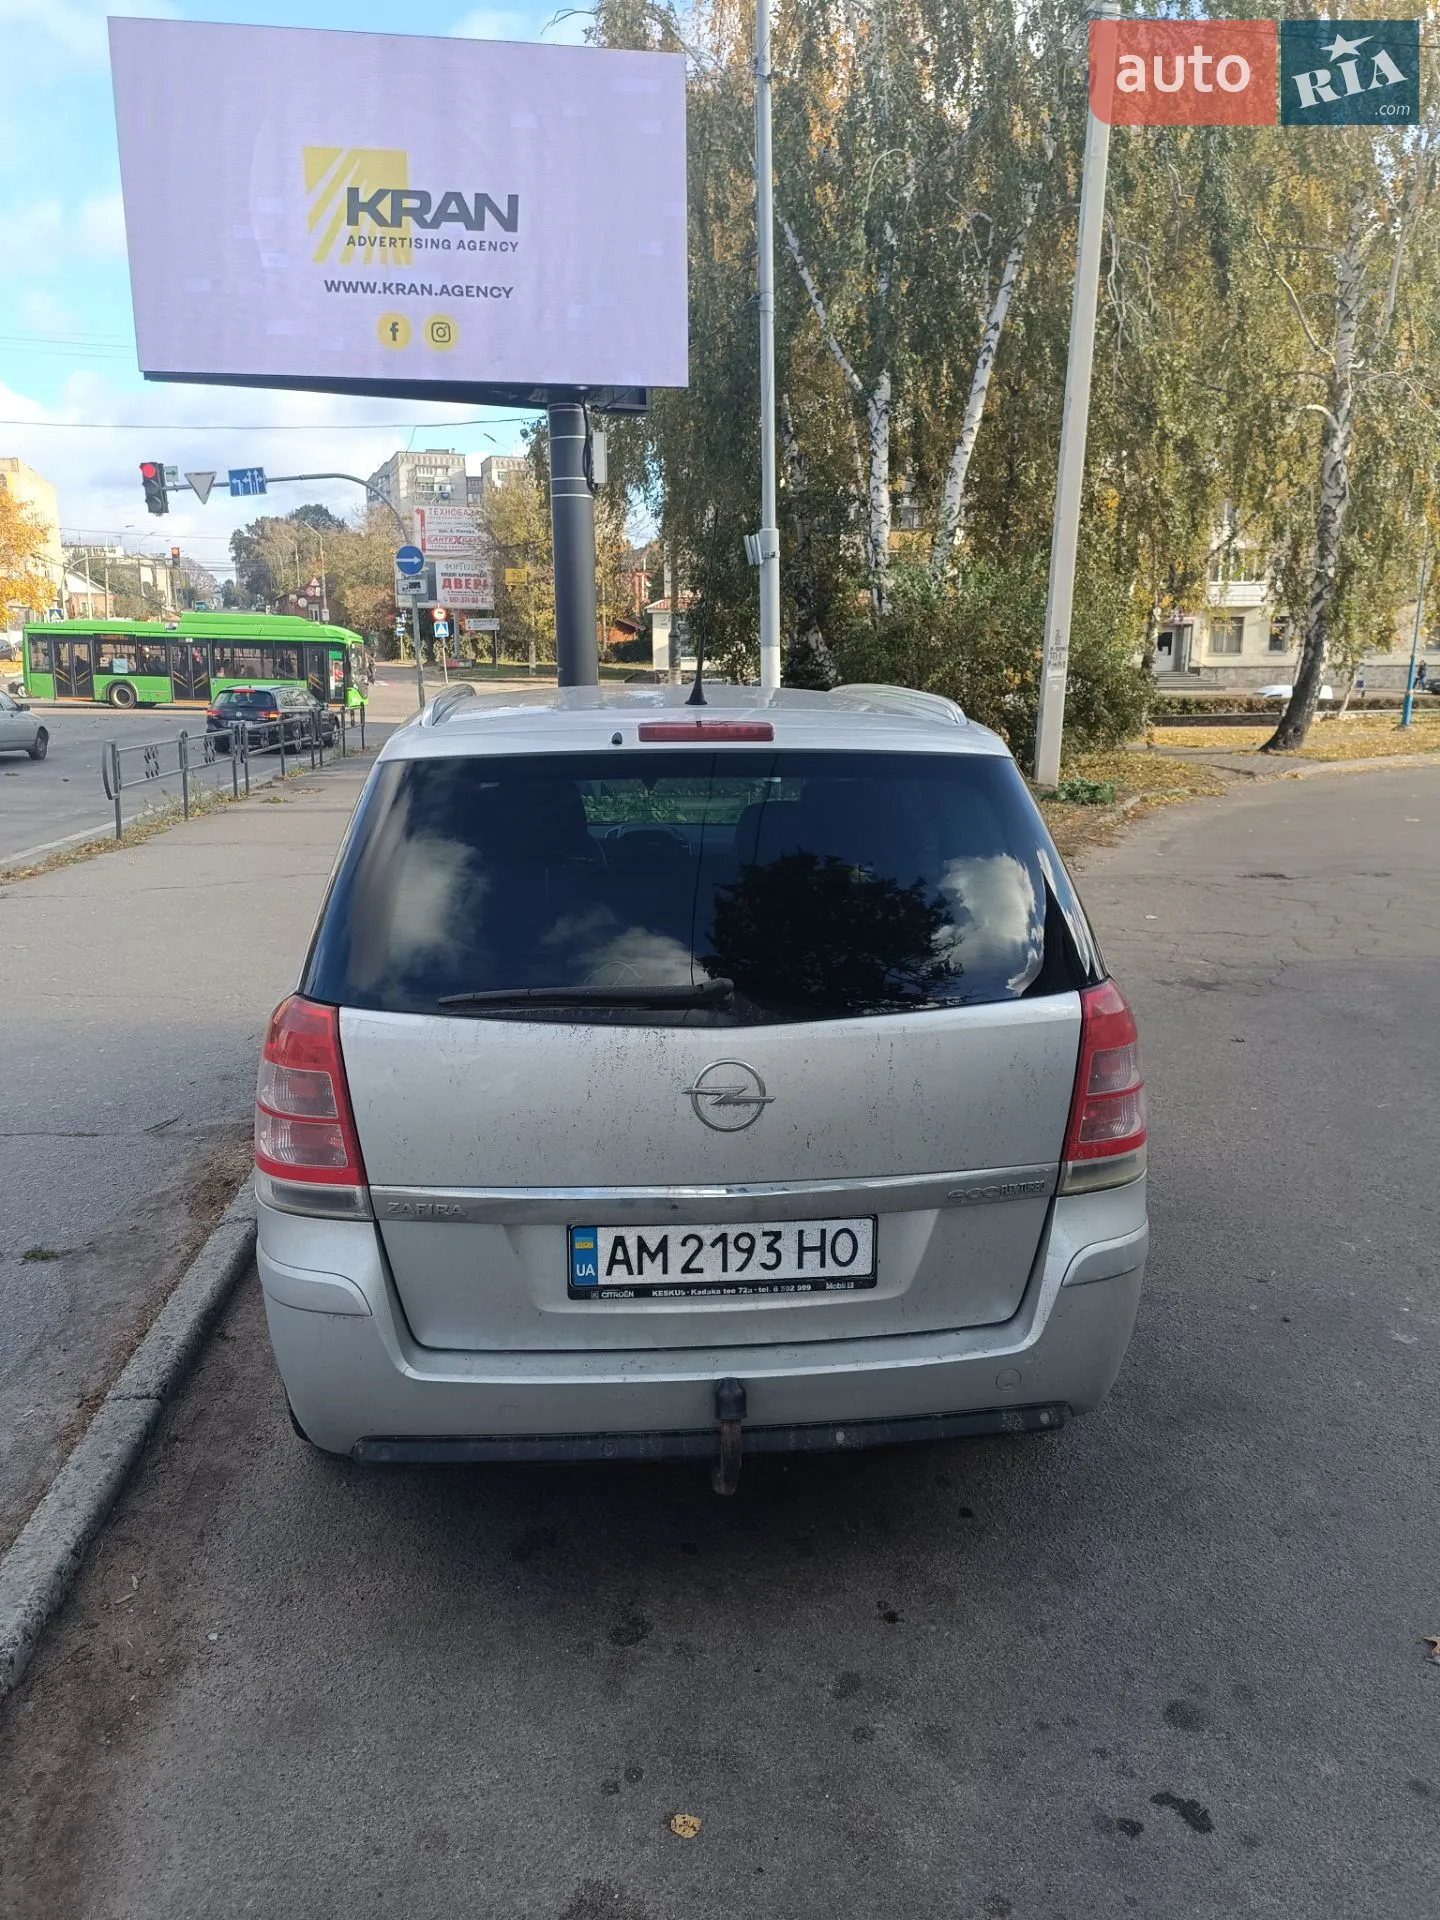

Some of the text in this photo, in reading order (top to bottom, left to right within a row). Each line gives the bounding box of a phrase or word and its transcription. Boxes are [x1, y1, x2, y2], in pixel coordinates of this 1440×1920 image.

[346, 187, 519, 232] KRAN
[346, 235, 519, 253] ADVERTISING AGENCY
[324, 279, 514, 299] WWW.KRAN.AGENCY
[386, 1202, 466, 1216] ZAFIRA
[605, 1227, 859, 1276] AM 2193 HO
[576, 1264, 596, 1276] UA
[690, 1287, 721, 1296] Kadaka
